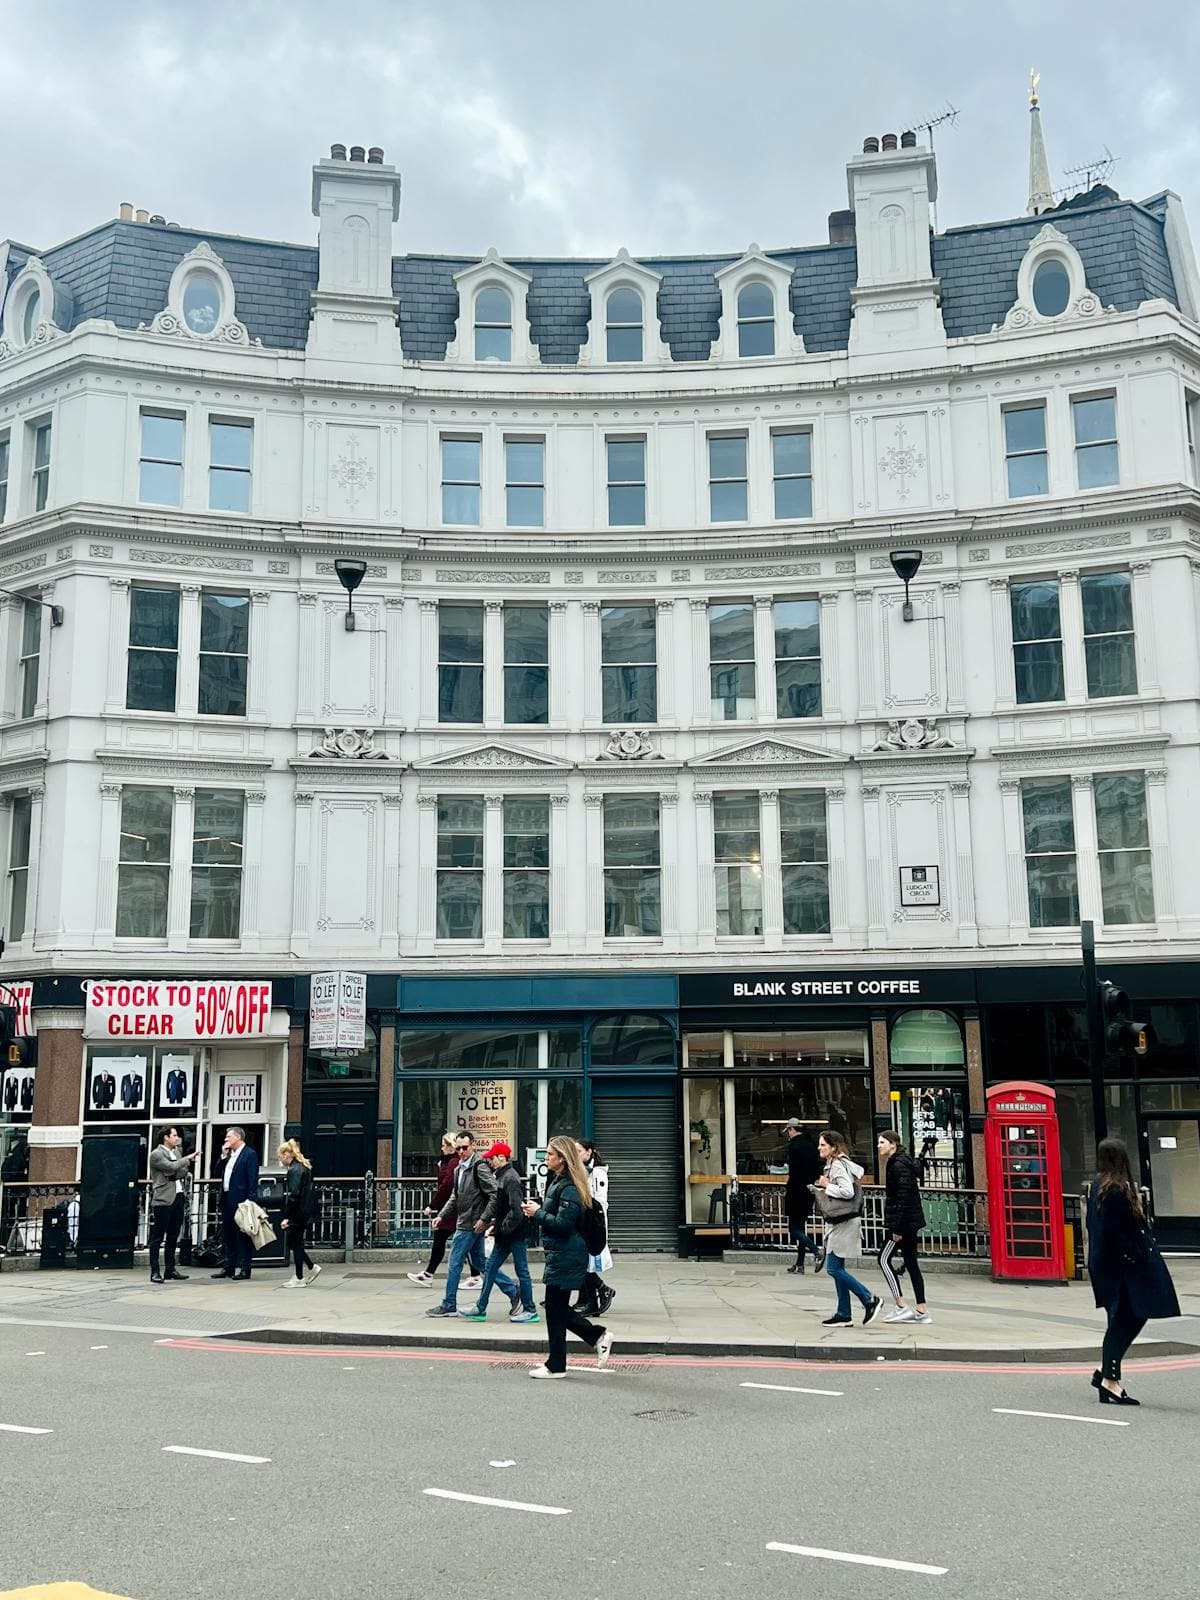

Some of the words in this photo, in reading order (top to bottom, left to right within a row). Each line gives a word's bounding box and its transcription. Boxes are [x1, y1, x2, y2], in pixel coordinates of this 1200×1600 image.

[313, 986, 322, 999] TO
[324, 984, 336, 998] LET
[342, 984, 352, 998] TO
[353, 986, 364, 999] LET
[733, 982, 786, 996] BLANK
[791, 981, 853, 995] STREET
[857, 980, 920, 994] COFFEE
[92, 985, 159, 1007] STOCK
[166, 985, 191, 1007] TO
[108, 1014, 174, 1036] CLEAR
[461, 1087, 468, 1096] &
[470, 1087, 504, 1095] OFFICES
[458, 1096, 478, 1111] TO
[484, 1096, 507, 1110] LET
[912, 1120, 936, 1129] GRAB
[913, 1130, 947, 1139] COFFEE
